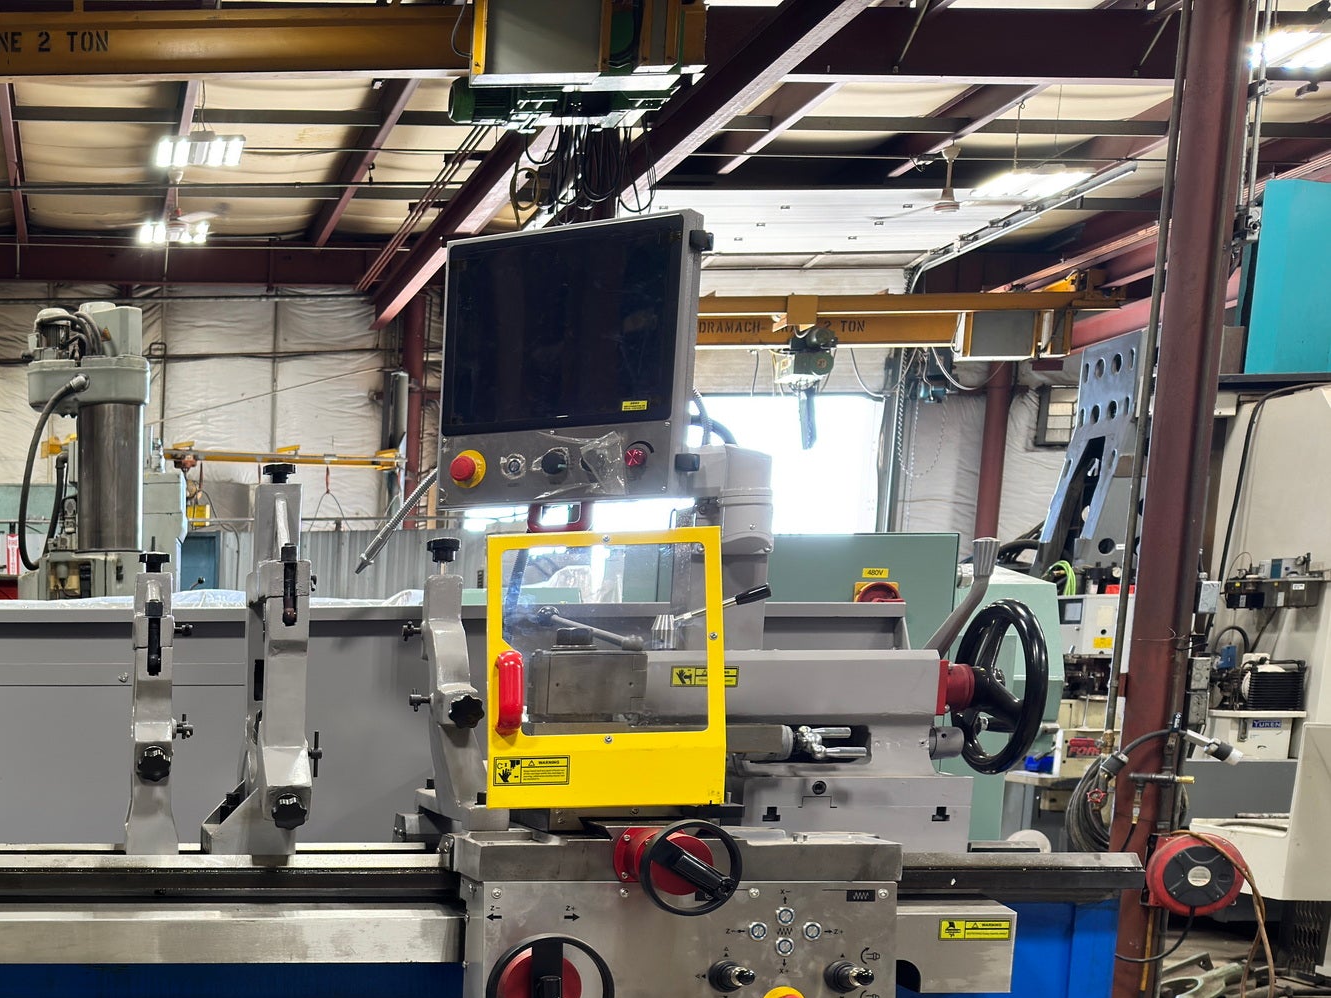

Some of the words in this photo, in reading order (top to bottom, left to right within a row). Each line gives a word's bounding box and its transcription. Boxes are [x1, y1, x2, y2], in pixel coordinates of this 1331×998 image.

[37, 31, 51, 53] 2
[66, 30, 109, 53] TON
[840, 320, 866, 333] TON
